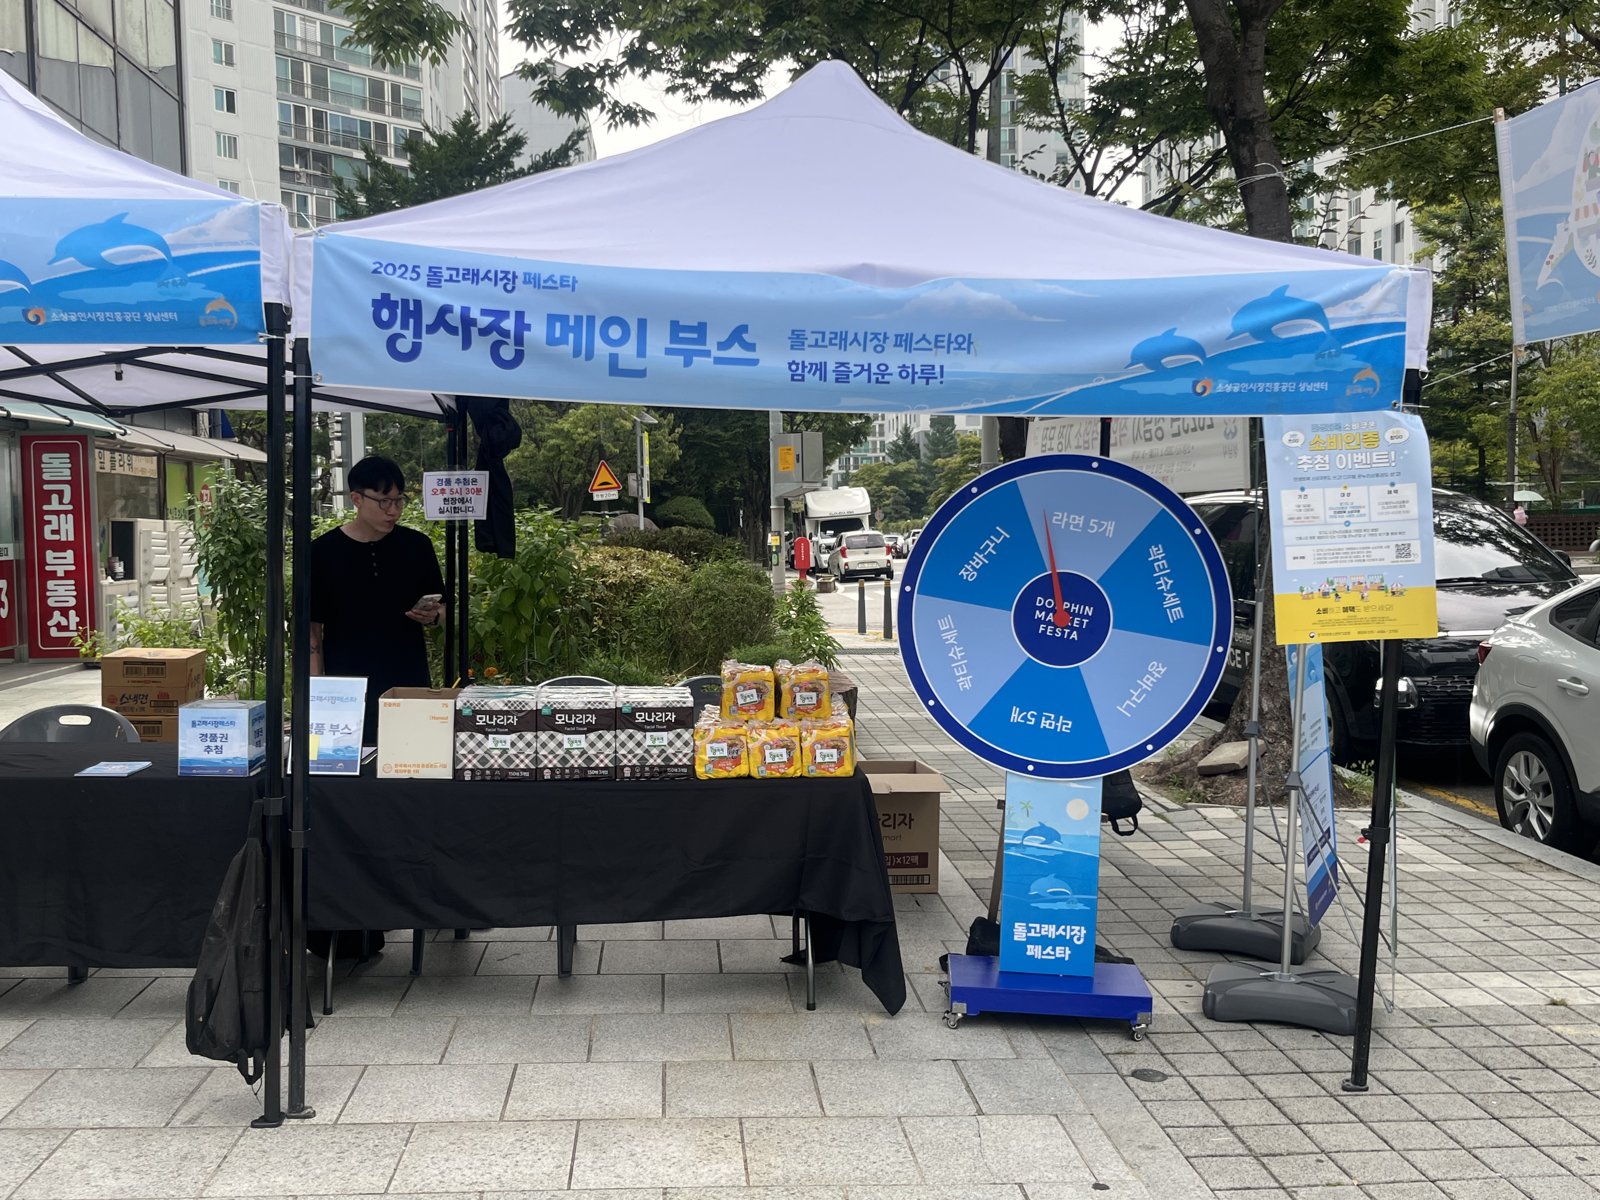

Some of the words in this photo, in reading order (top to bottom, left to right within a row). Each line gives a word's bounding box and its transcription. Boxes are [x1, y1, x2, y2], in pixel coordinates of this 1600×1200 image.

[371, 261, 421, 282] 2025
[426, 265, 518, 294] 돌고래시장
[522, 271, 578, 293] 페스타
[51, 311, 141, 322] 소상공인시장진흥공단
[143, 310, 178, 322] 성남센터
[371, 292, 532, 371] 행사장
[545, 312, 648, 379] 메인
[664, 319, 761, 368] 부스
[788, 329, 889, 354] 돌고래시장
[893, 332, 974, 355] 페스타와
[787, 360, 828, 382] 함께
[832, 361, 893, 385] 즐거운
[898, 363, 945, 386] 하루!
[1216, 382, 1297, 393] 소상공인시장진흥공단
[1298, 381, 1328, 392] 성남센터
[1308, 431, 1380, 451] 소비인증
[1297, 453, 1330, 471] 추첨
[1336, 450, 1396, 470] 이벤트!
[437, 478, 452, 486] 경품
[455, 477, 478, 486] 추첨은
[41, 452, 75, 542] 돌고래
[431, 488, 447, 496] 오후
[450, 487, 462, 496] 5시
[465, 487, 482, 496] 30분
[443, 497, 473, 505] 현장에서
[1052, 511, 1082, 532] 라면
[1087, 518, 1115, 538] 5개
[958, 526, 1011, 583] 장바구니
[1147, 544, 1184, 624] 곽티슈세트
[45, 549, 80, 639] 부동산
[1036, 596, 1094, 616] DOPHIN
[1035, 610, 1089, 629] MAET
[1038, 624, 1078, 640] FESTA
[937, 614, 972, 691] 곽티슈세트
[1116, 660, 1168, 717] 장바구니
[310, 695, 357, 704] 고래시장페스타
[476, 714, 518, 726] 모나리자
[555, 713, 597, 725] 모나리자
[635, 712, 676, 723] 모나리자
[1010, 706, 1036, 725] 5개
[1040, 712, 1072, 733] 라면
[199, 733, 229, 743] 경품권
[329, 723, 352, 736] 부스
[203, 745, 223, 754] 추첨
[879, 812, 915, 830] 리자
[1013, 922, 1086, 945] 돌고래시장
[1026, 944, 1071, 961] 페스타
